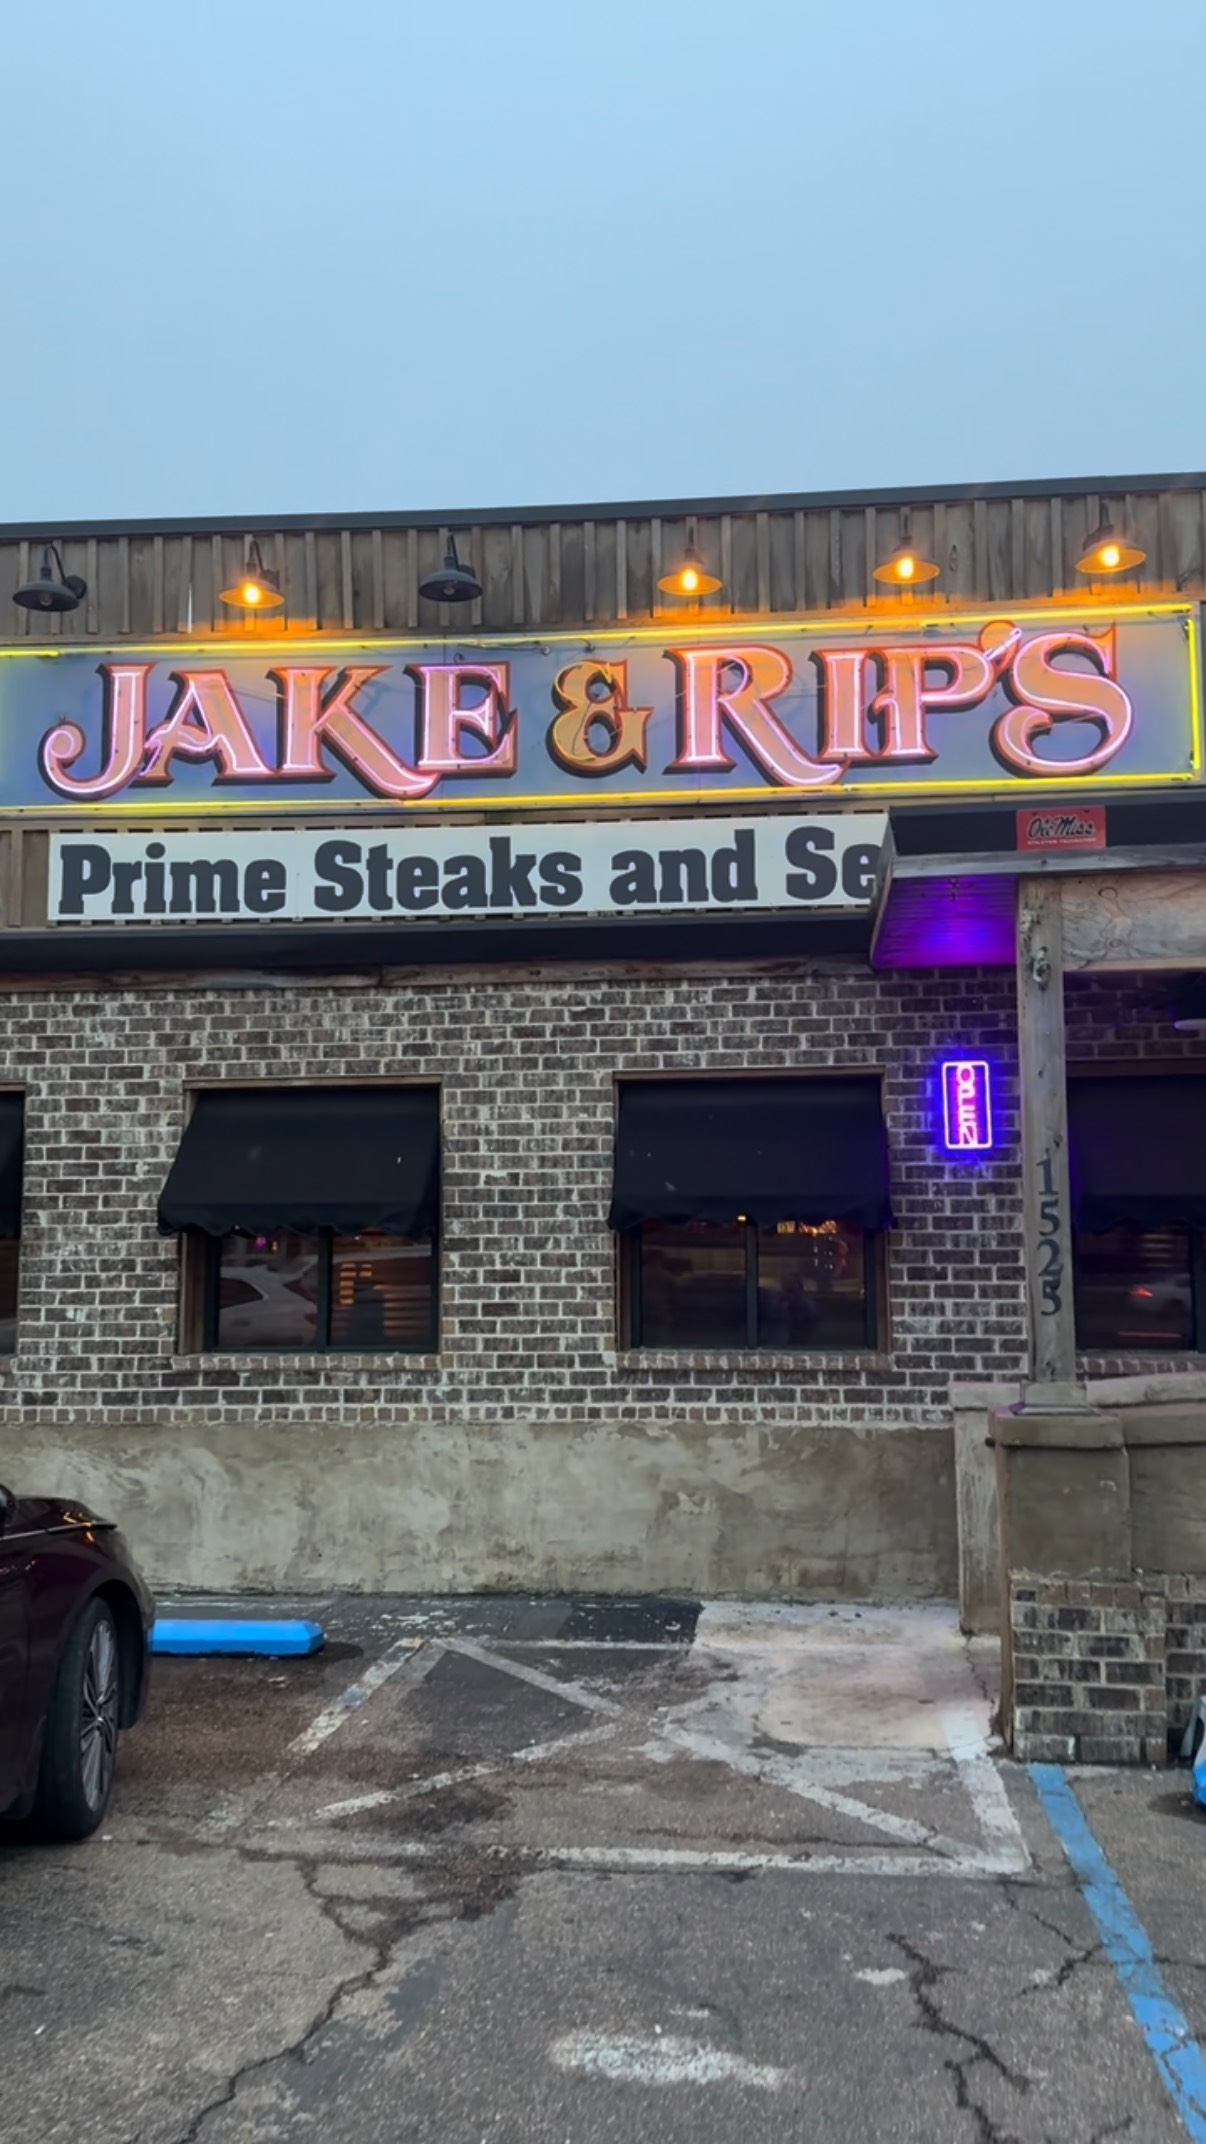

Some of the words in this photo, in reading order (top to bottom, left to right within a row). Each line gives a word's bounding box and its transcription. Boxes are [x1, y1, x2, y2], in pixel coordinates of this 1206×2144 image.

[37, 661, 518, 800] JAKE
[547, 660, 653, 775] &
[663, 620, 1134, 786] RIP'S
[58, 841, 287, 914] Prime
[313, 836, 584, 911] Steaks
[610, 828, 758, 904] and
[956, 1062, 979, 1148] OPEN
[1036, 1156, 1064, 1316] 1525
